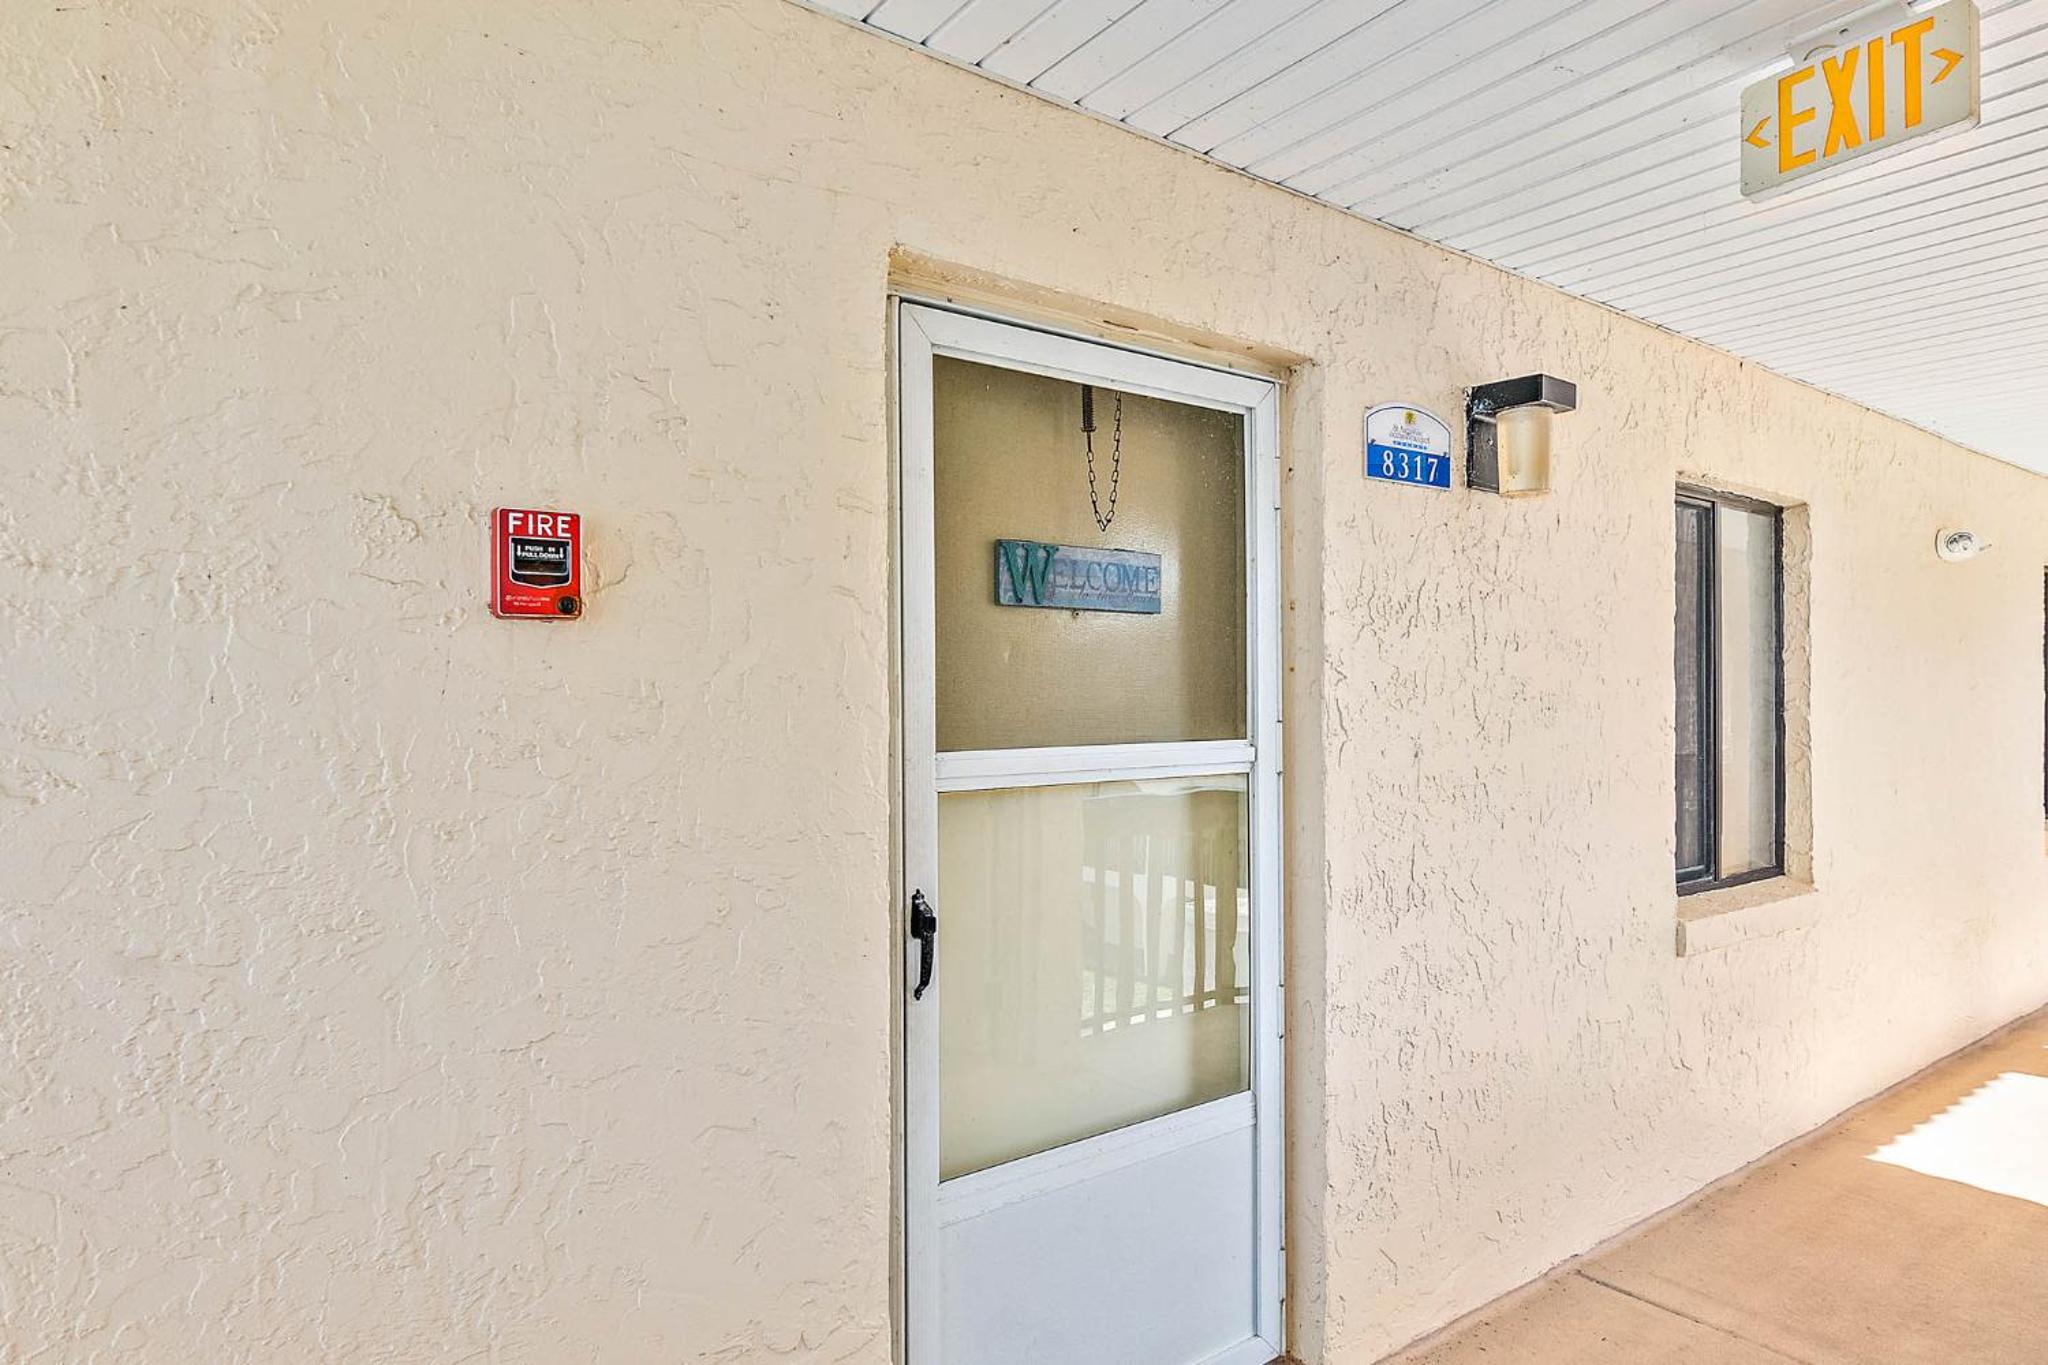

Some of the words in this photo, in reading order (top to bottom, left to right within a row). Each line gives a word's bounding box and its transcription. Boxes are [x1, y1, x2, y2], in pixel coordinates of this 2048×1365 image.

[1778, 16, 1934, 174] EXIT
[1382, 450, 1438, 482] 8317
[508, 512, 572, 537] FIRE
[1001, 542, 1160, 604] WELCOME
